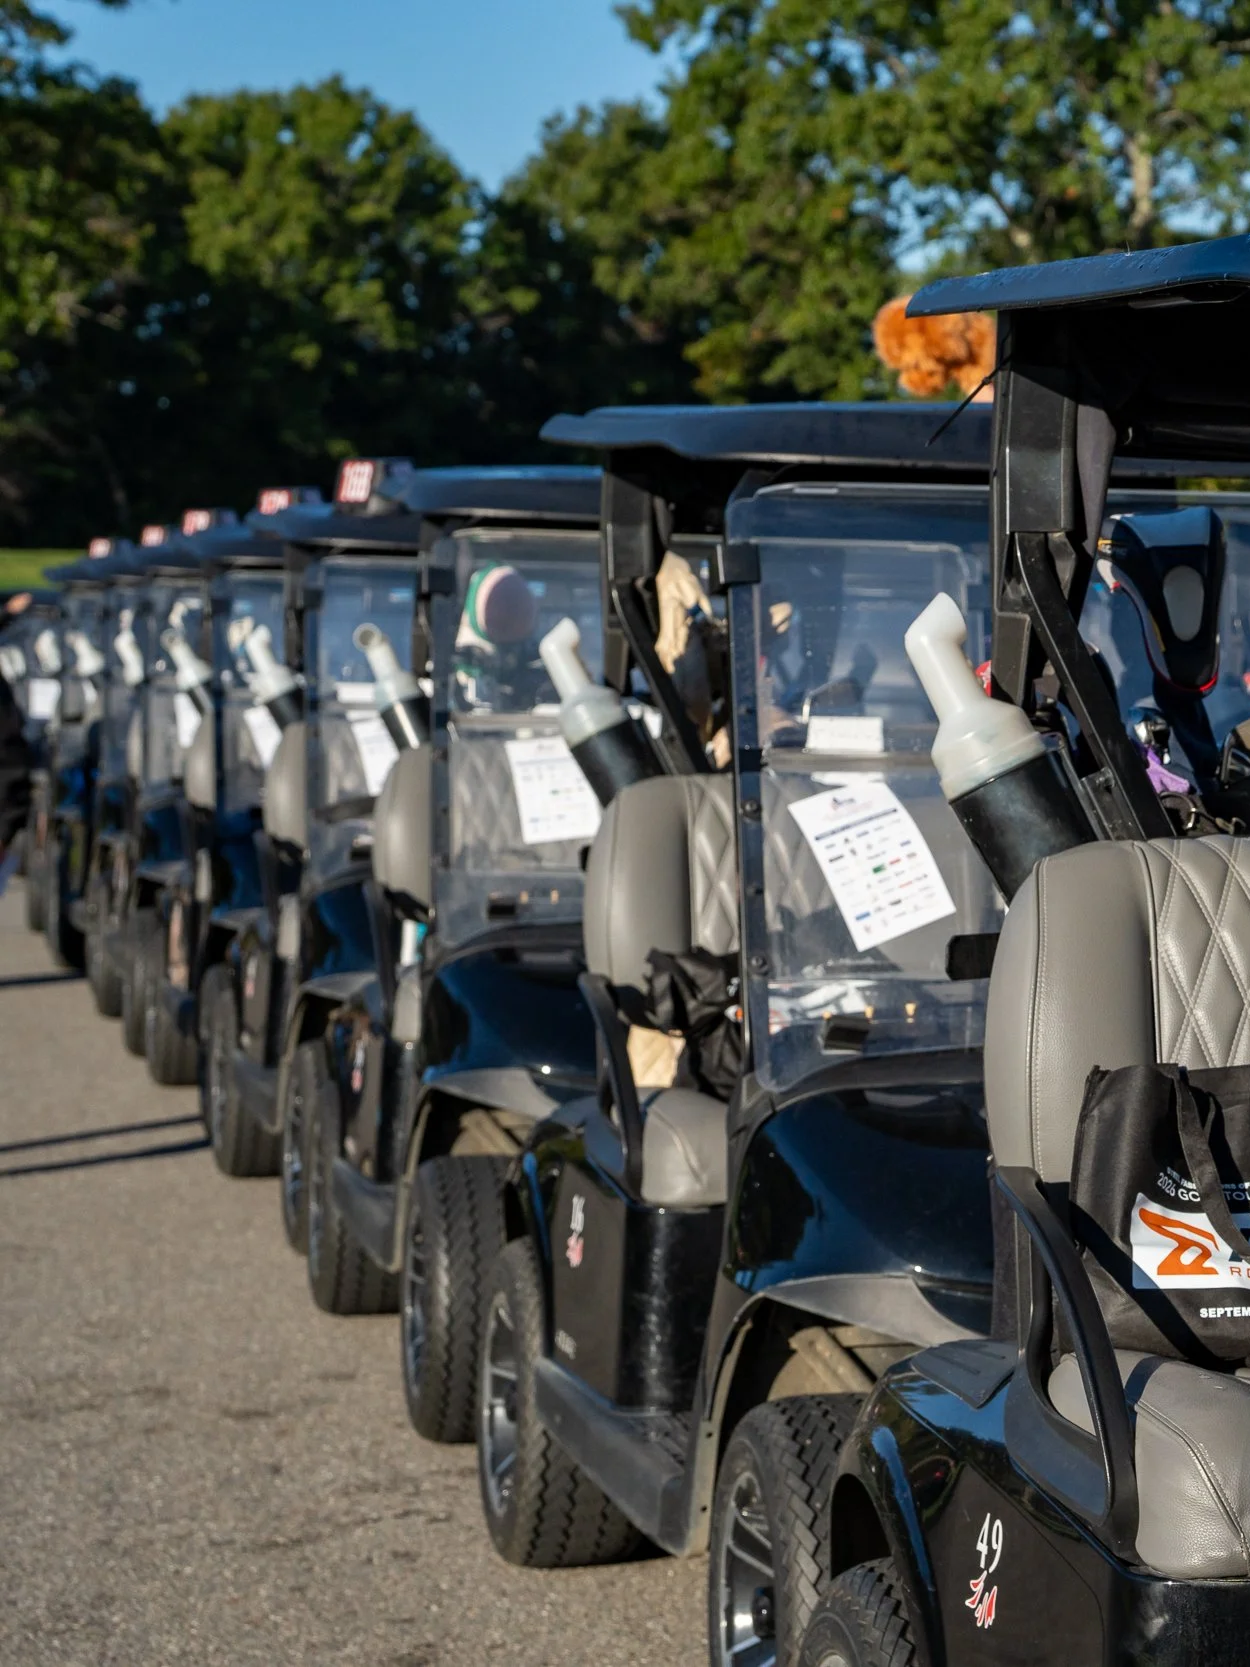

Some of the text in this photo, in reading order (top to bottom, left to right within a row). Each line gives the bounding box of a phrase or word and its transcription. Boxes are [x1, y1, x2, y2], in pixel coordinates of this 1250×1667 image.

[1238, 1182, 1250, 1190] OF
[1177, 1188, 1201, 1202] GO
[976, 1512, 1003, 1574] 49
